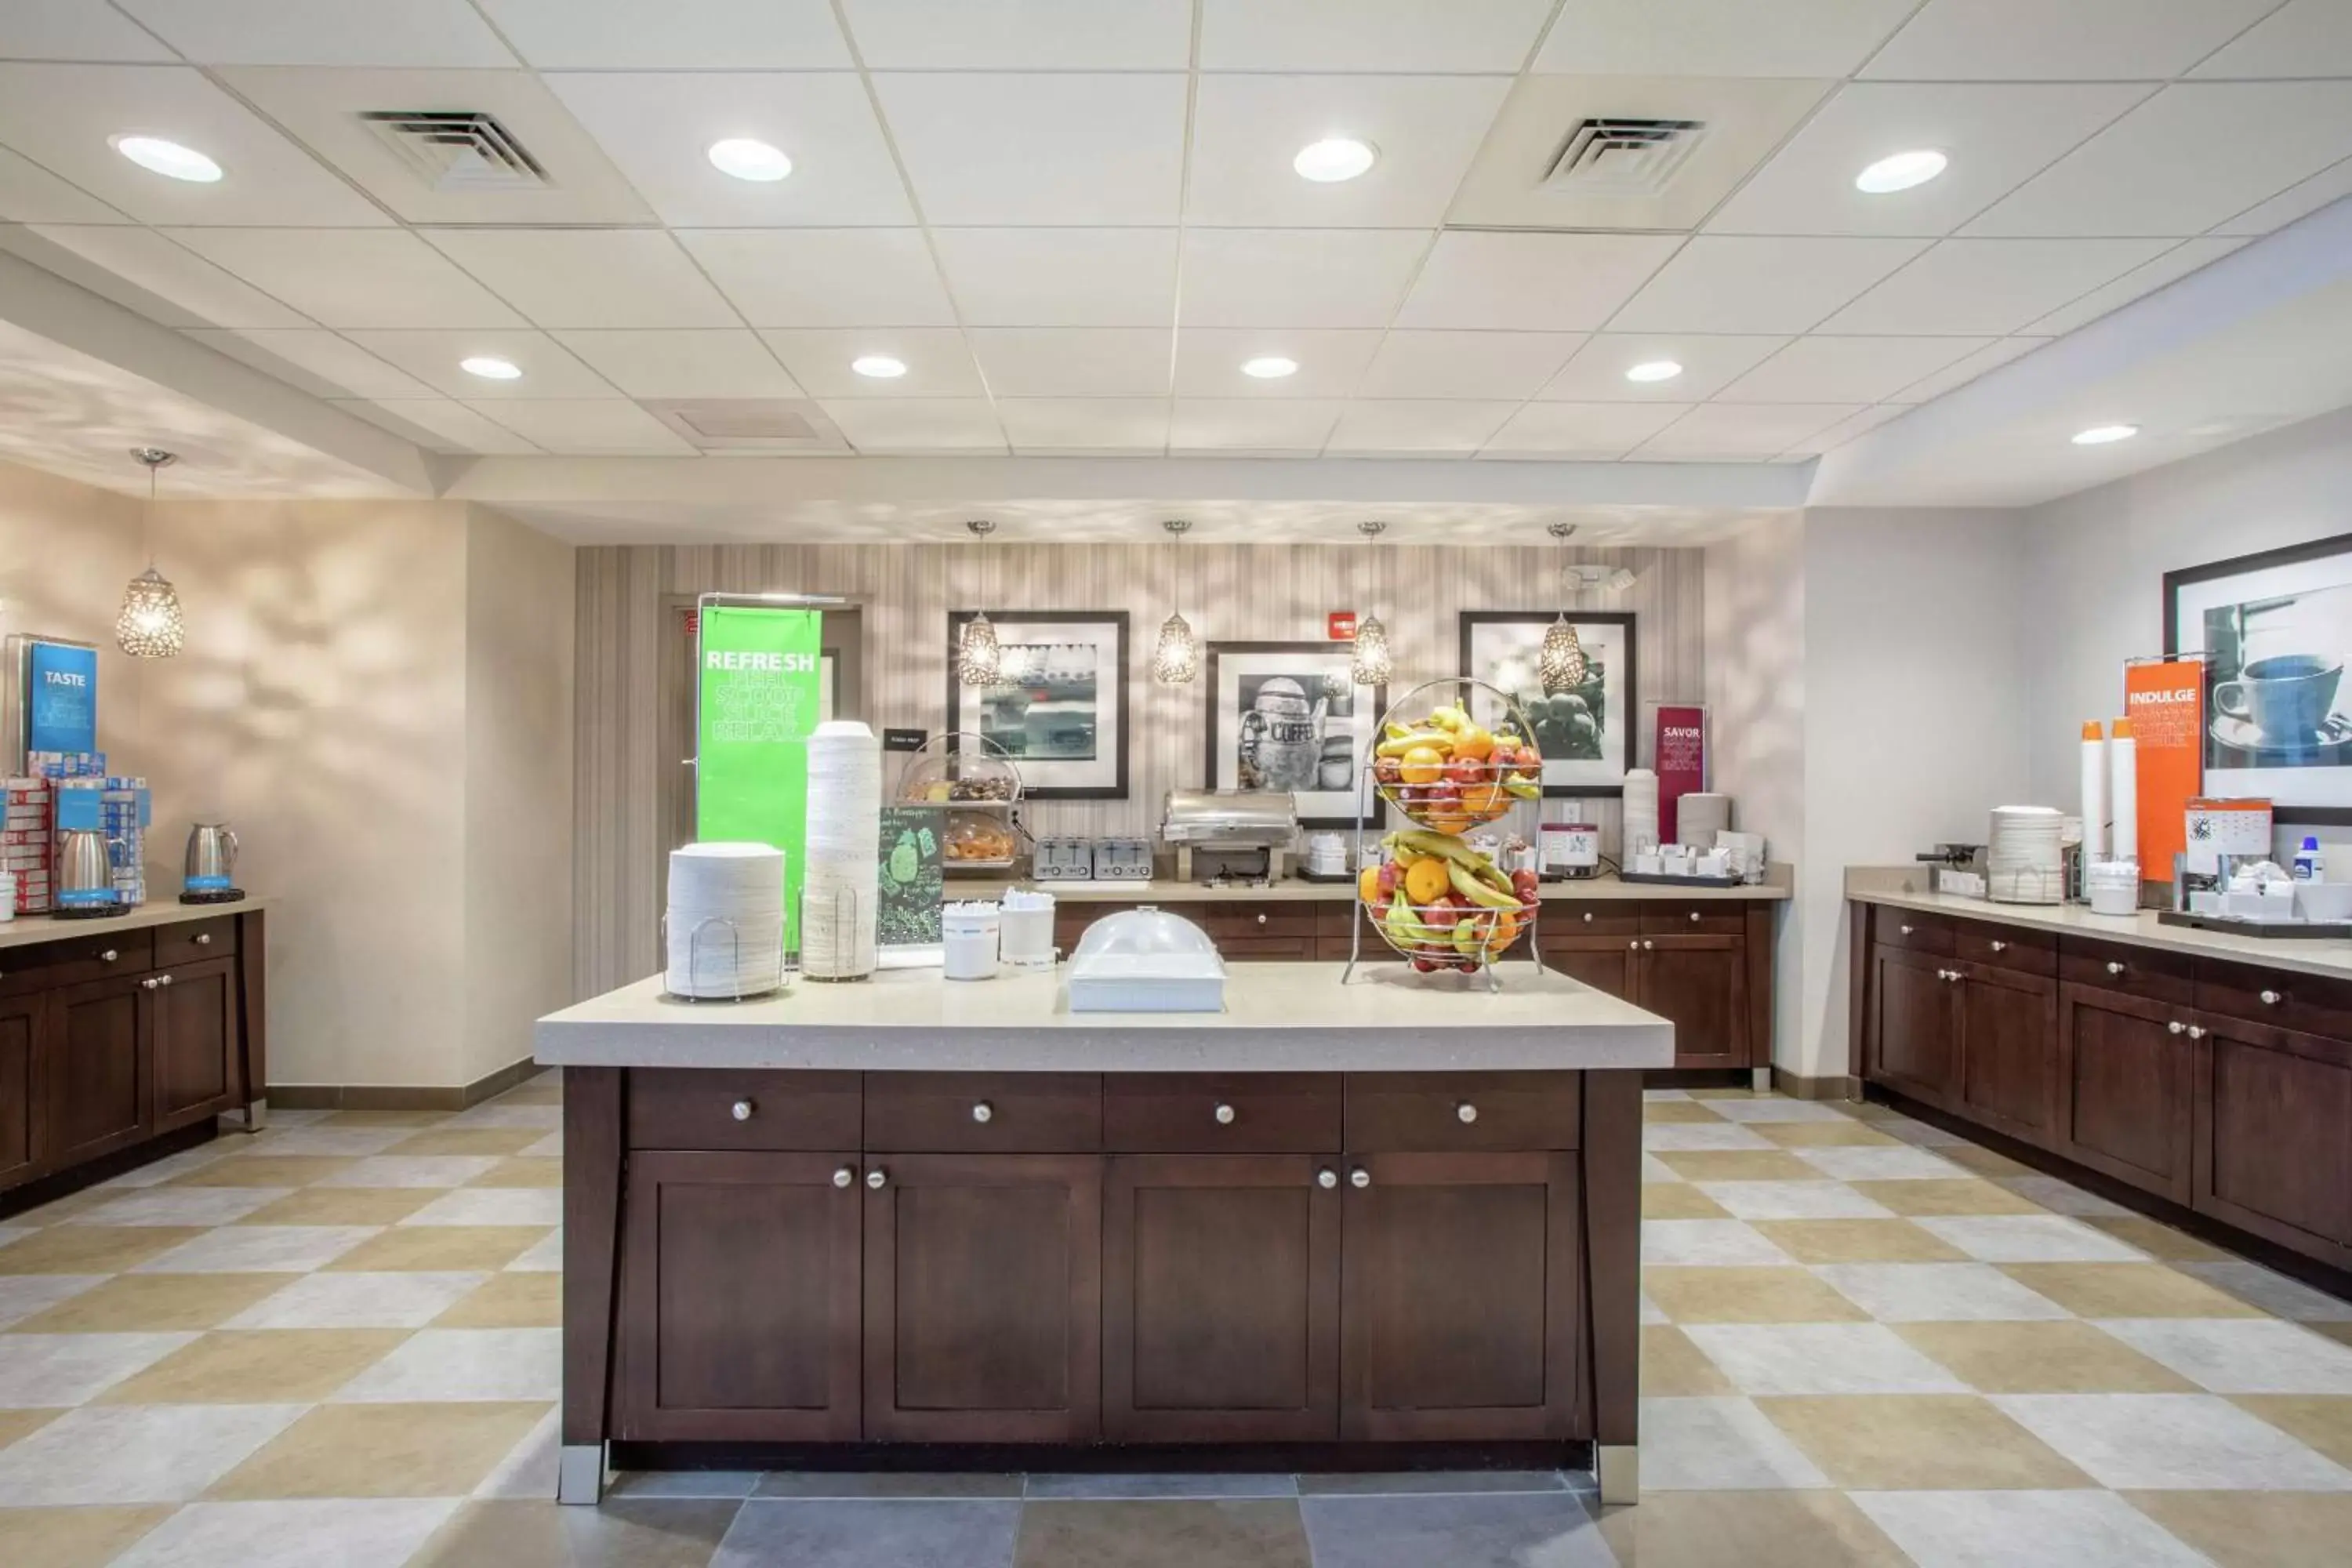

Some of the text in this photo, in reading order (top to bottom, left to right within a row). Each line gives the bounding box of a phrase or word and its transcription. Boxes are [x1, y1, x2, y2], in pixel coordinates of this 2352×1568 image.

[706, 650, 815, 672] REFRESH
[45, 670, 85, 687] TASTE
[2130, 688, 2196, 703] INDULGE
[1664, 727, 1700, 738] SAVOR
